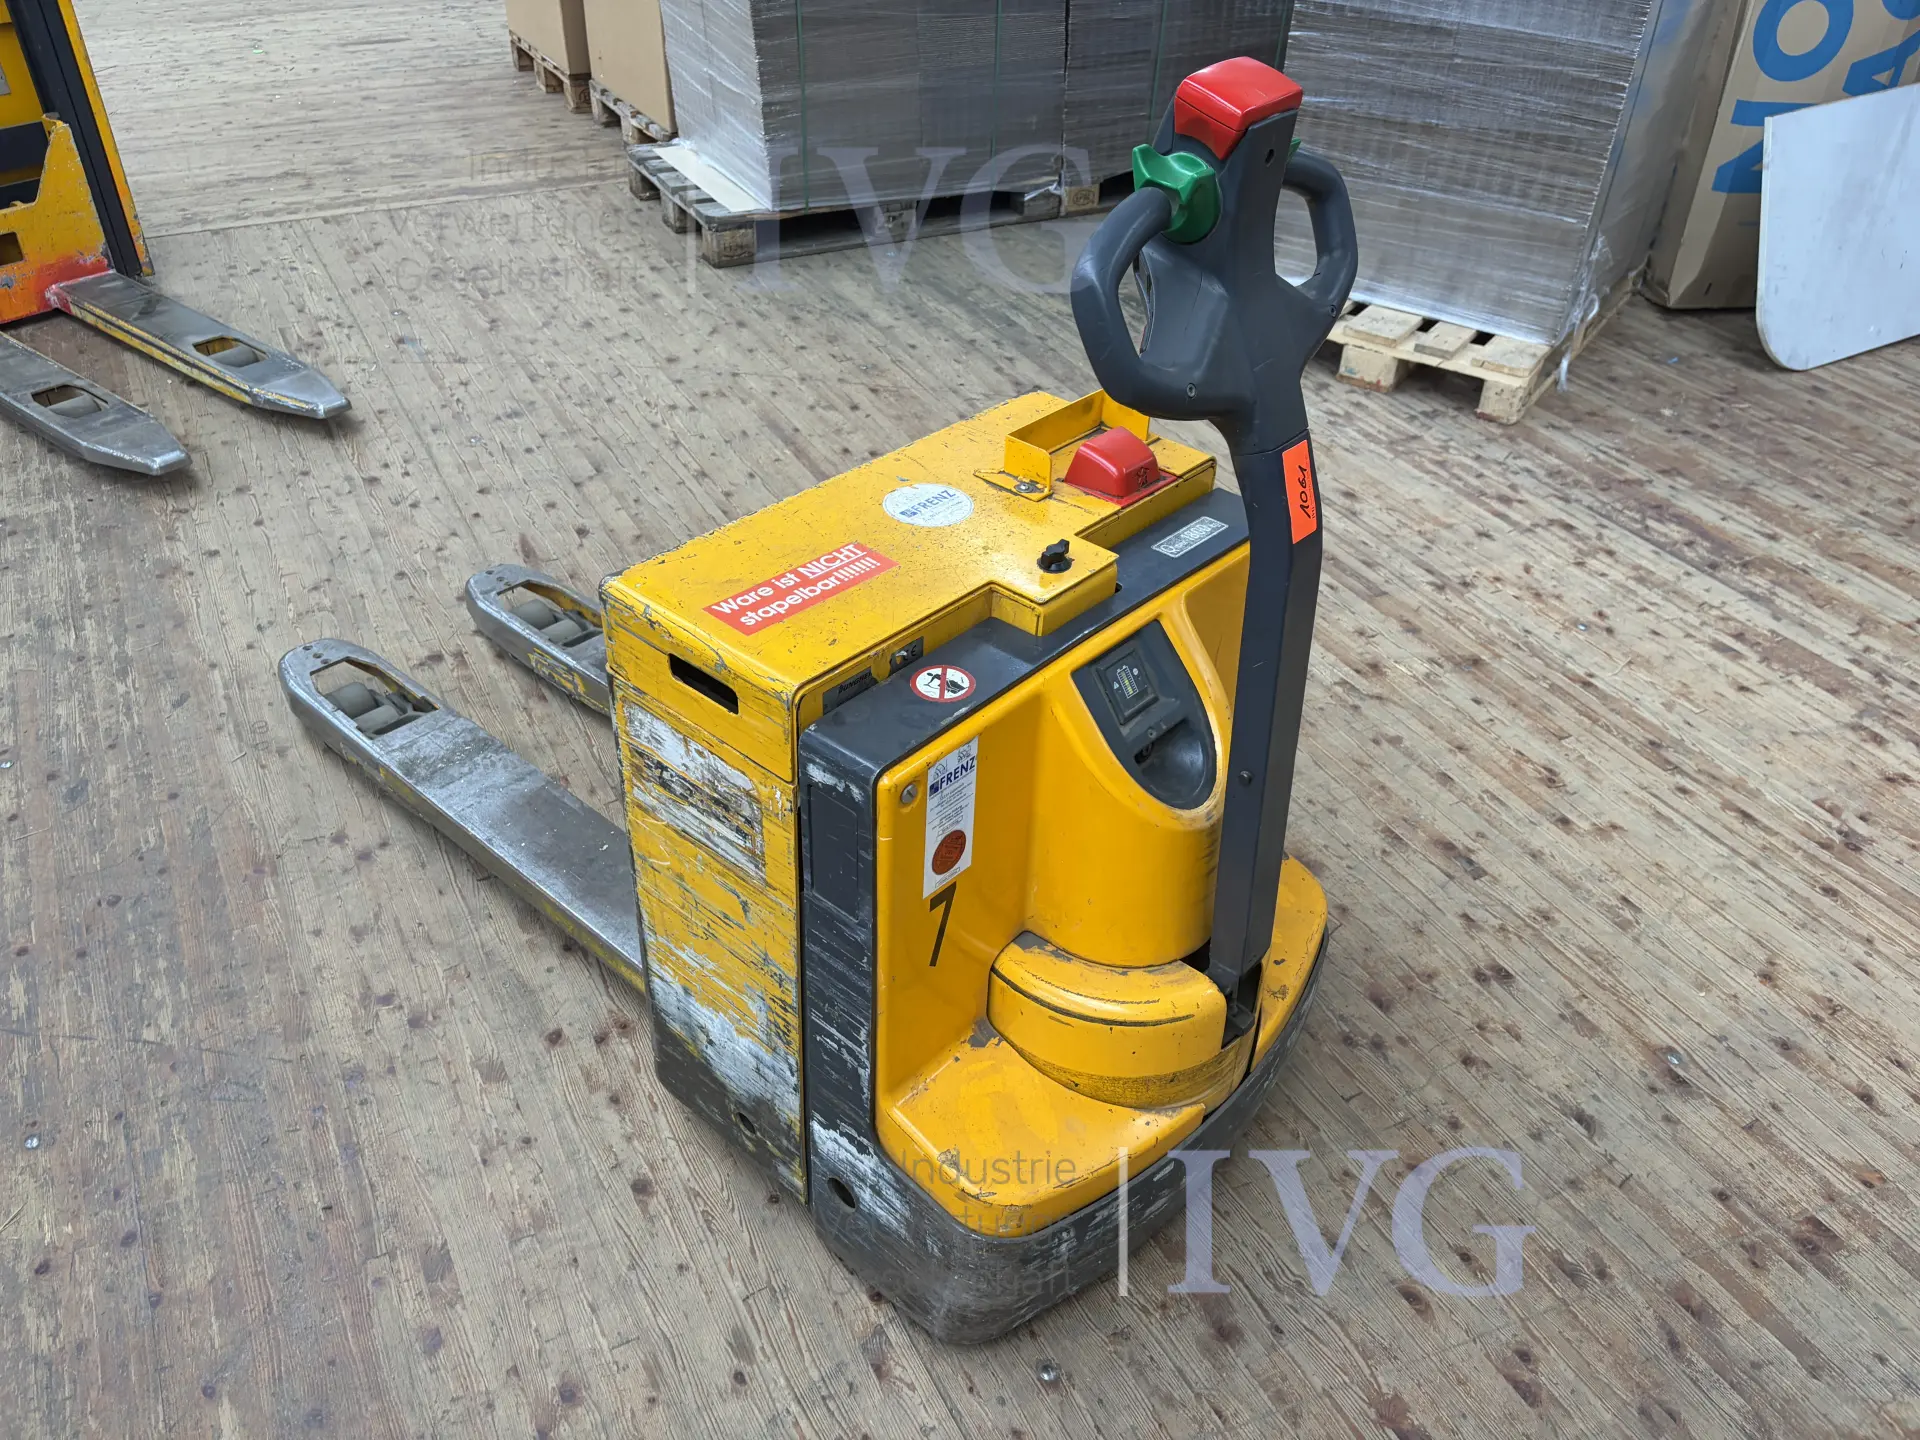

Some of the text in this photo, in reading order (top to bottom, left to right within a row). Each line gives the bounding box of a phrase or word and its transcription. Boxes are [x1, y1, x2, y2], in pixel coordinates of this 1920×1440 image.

[912, 489, 957, 515] FRENZ
[1298, 464, 1312, 519] 1061
[711, 544, 867, 614] Ware ist NICHT
[938, 755, 976, 791] FRENZ
